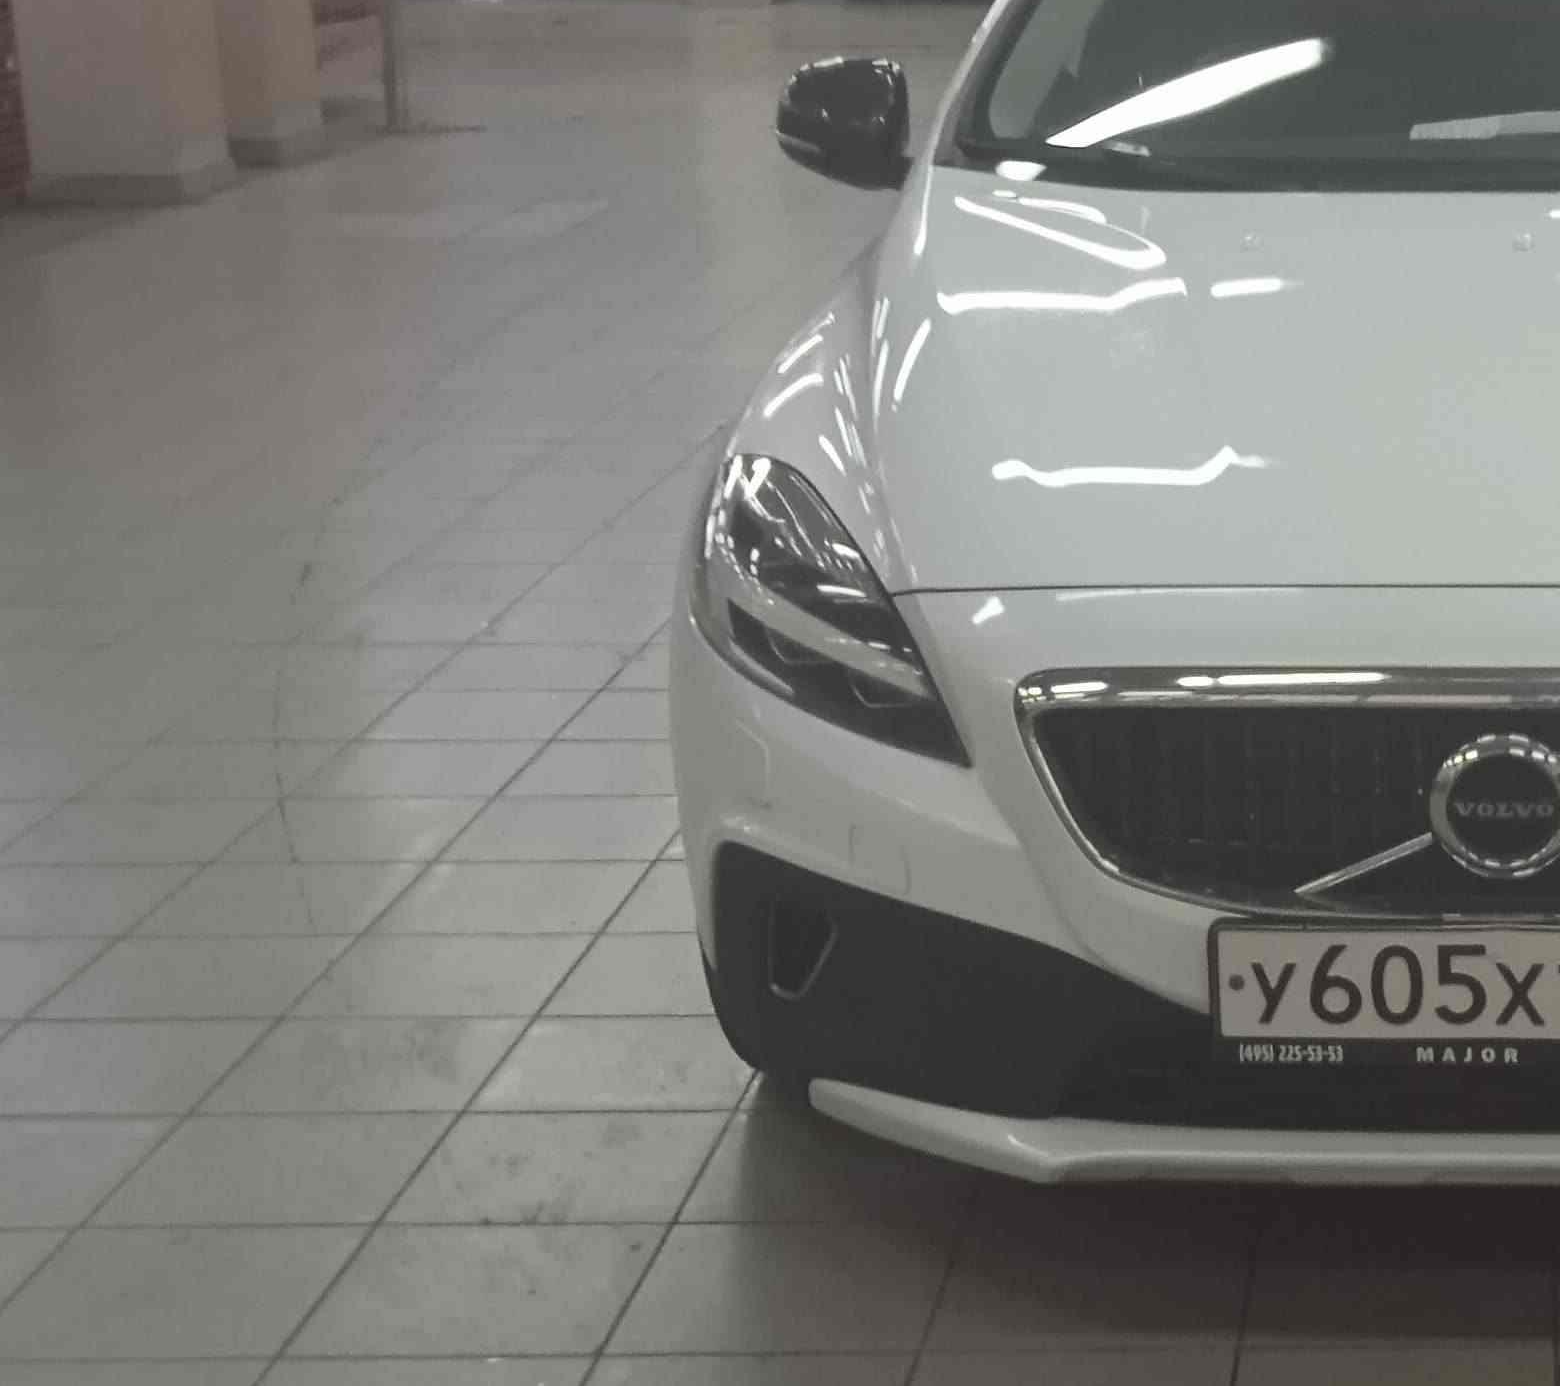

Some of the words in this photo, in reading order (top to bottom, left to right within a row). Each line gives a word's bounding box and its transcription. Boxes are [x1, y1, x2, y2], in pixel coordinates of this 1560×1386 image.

[1454, 802, 1554, 818] VOLVO
[1239, 1044, 1274, 1062] (495)
[1278, 1044, 1344, 1063] 225-53-53
[1416, 1046, 1519, 1064] MAJOR
